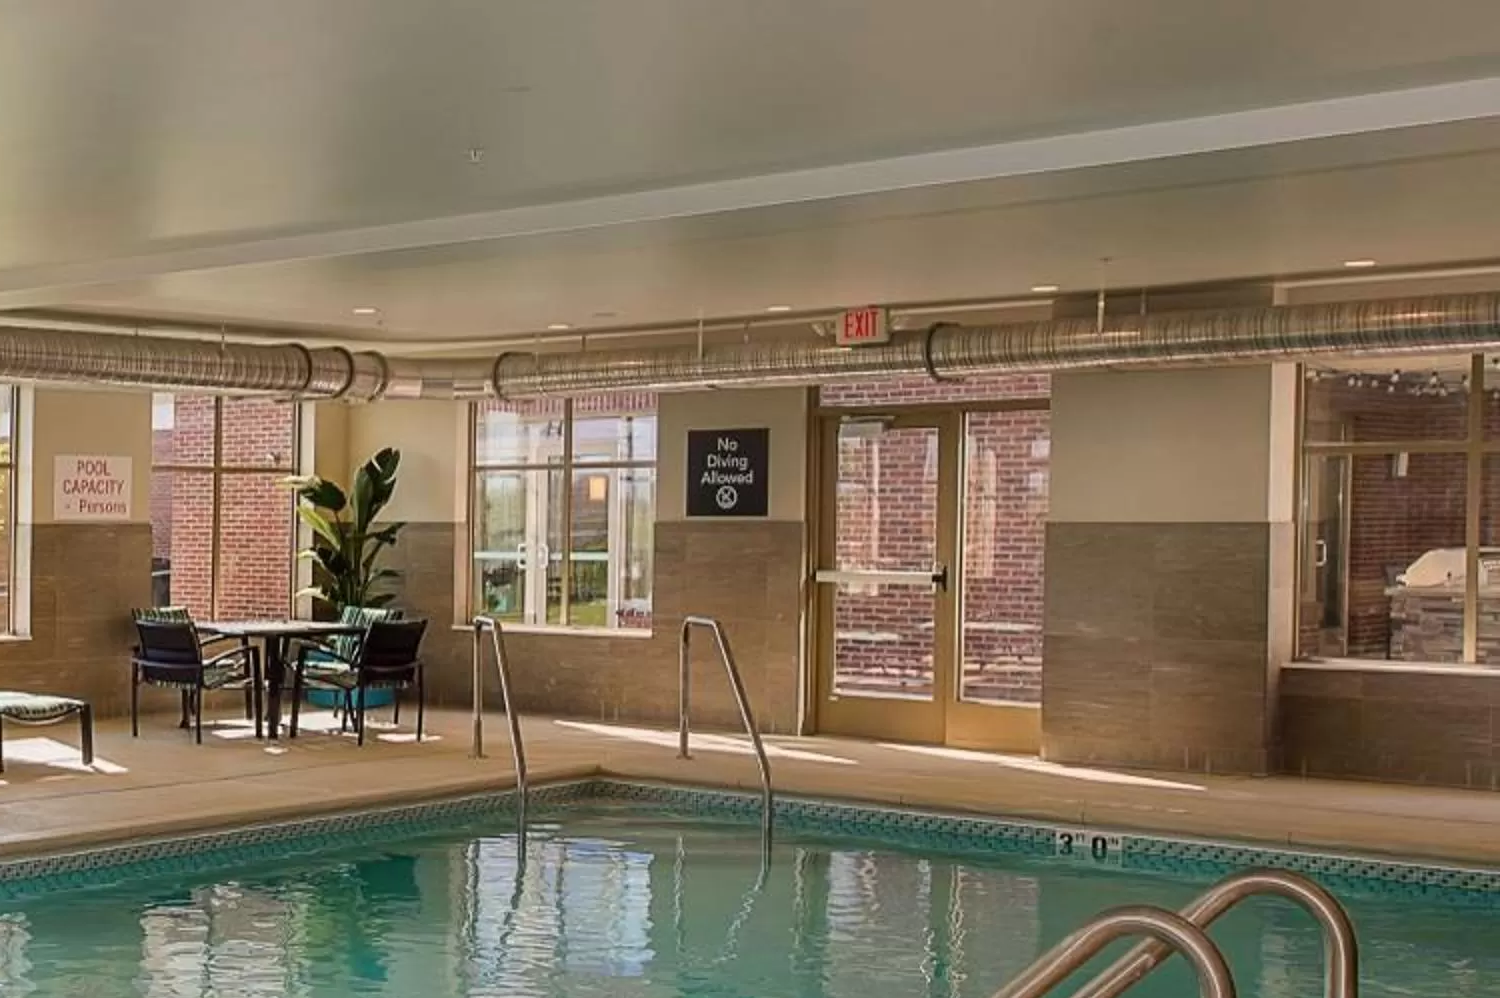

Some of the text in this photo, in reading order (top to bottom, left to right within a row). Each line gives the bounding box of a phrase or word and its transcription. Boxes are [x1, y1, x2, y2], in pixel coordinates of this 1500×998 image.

[845, 311, 877, 338] EXIT
[717, 438, 738, 451] No
[77, 460, 112, 476] POOL
[707, 453, 748, 470] Diving
[701, 470, 753, 484] Allowed
[63, 480, 124, 495] CAPACITY
